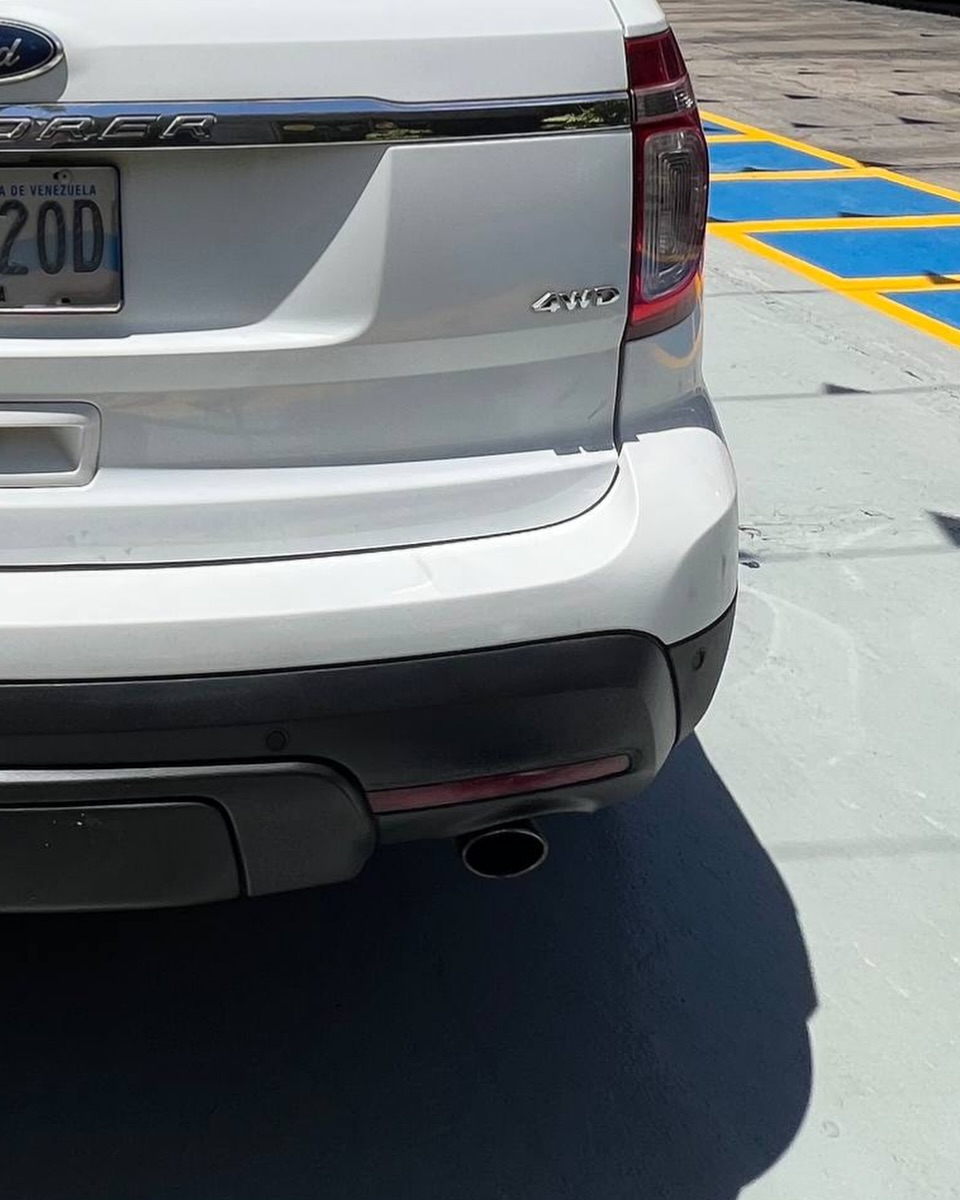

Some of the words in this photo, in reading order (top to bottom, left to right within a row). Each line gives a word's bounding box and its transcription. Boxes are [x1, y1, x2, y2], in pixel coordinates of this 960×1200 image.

[10, 184, 26, 197] DE
[29, 184, 98, 197] VENEZUELA
[530, 285, 621, 313] 4WD
